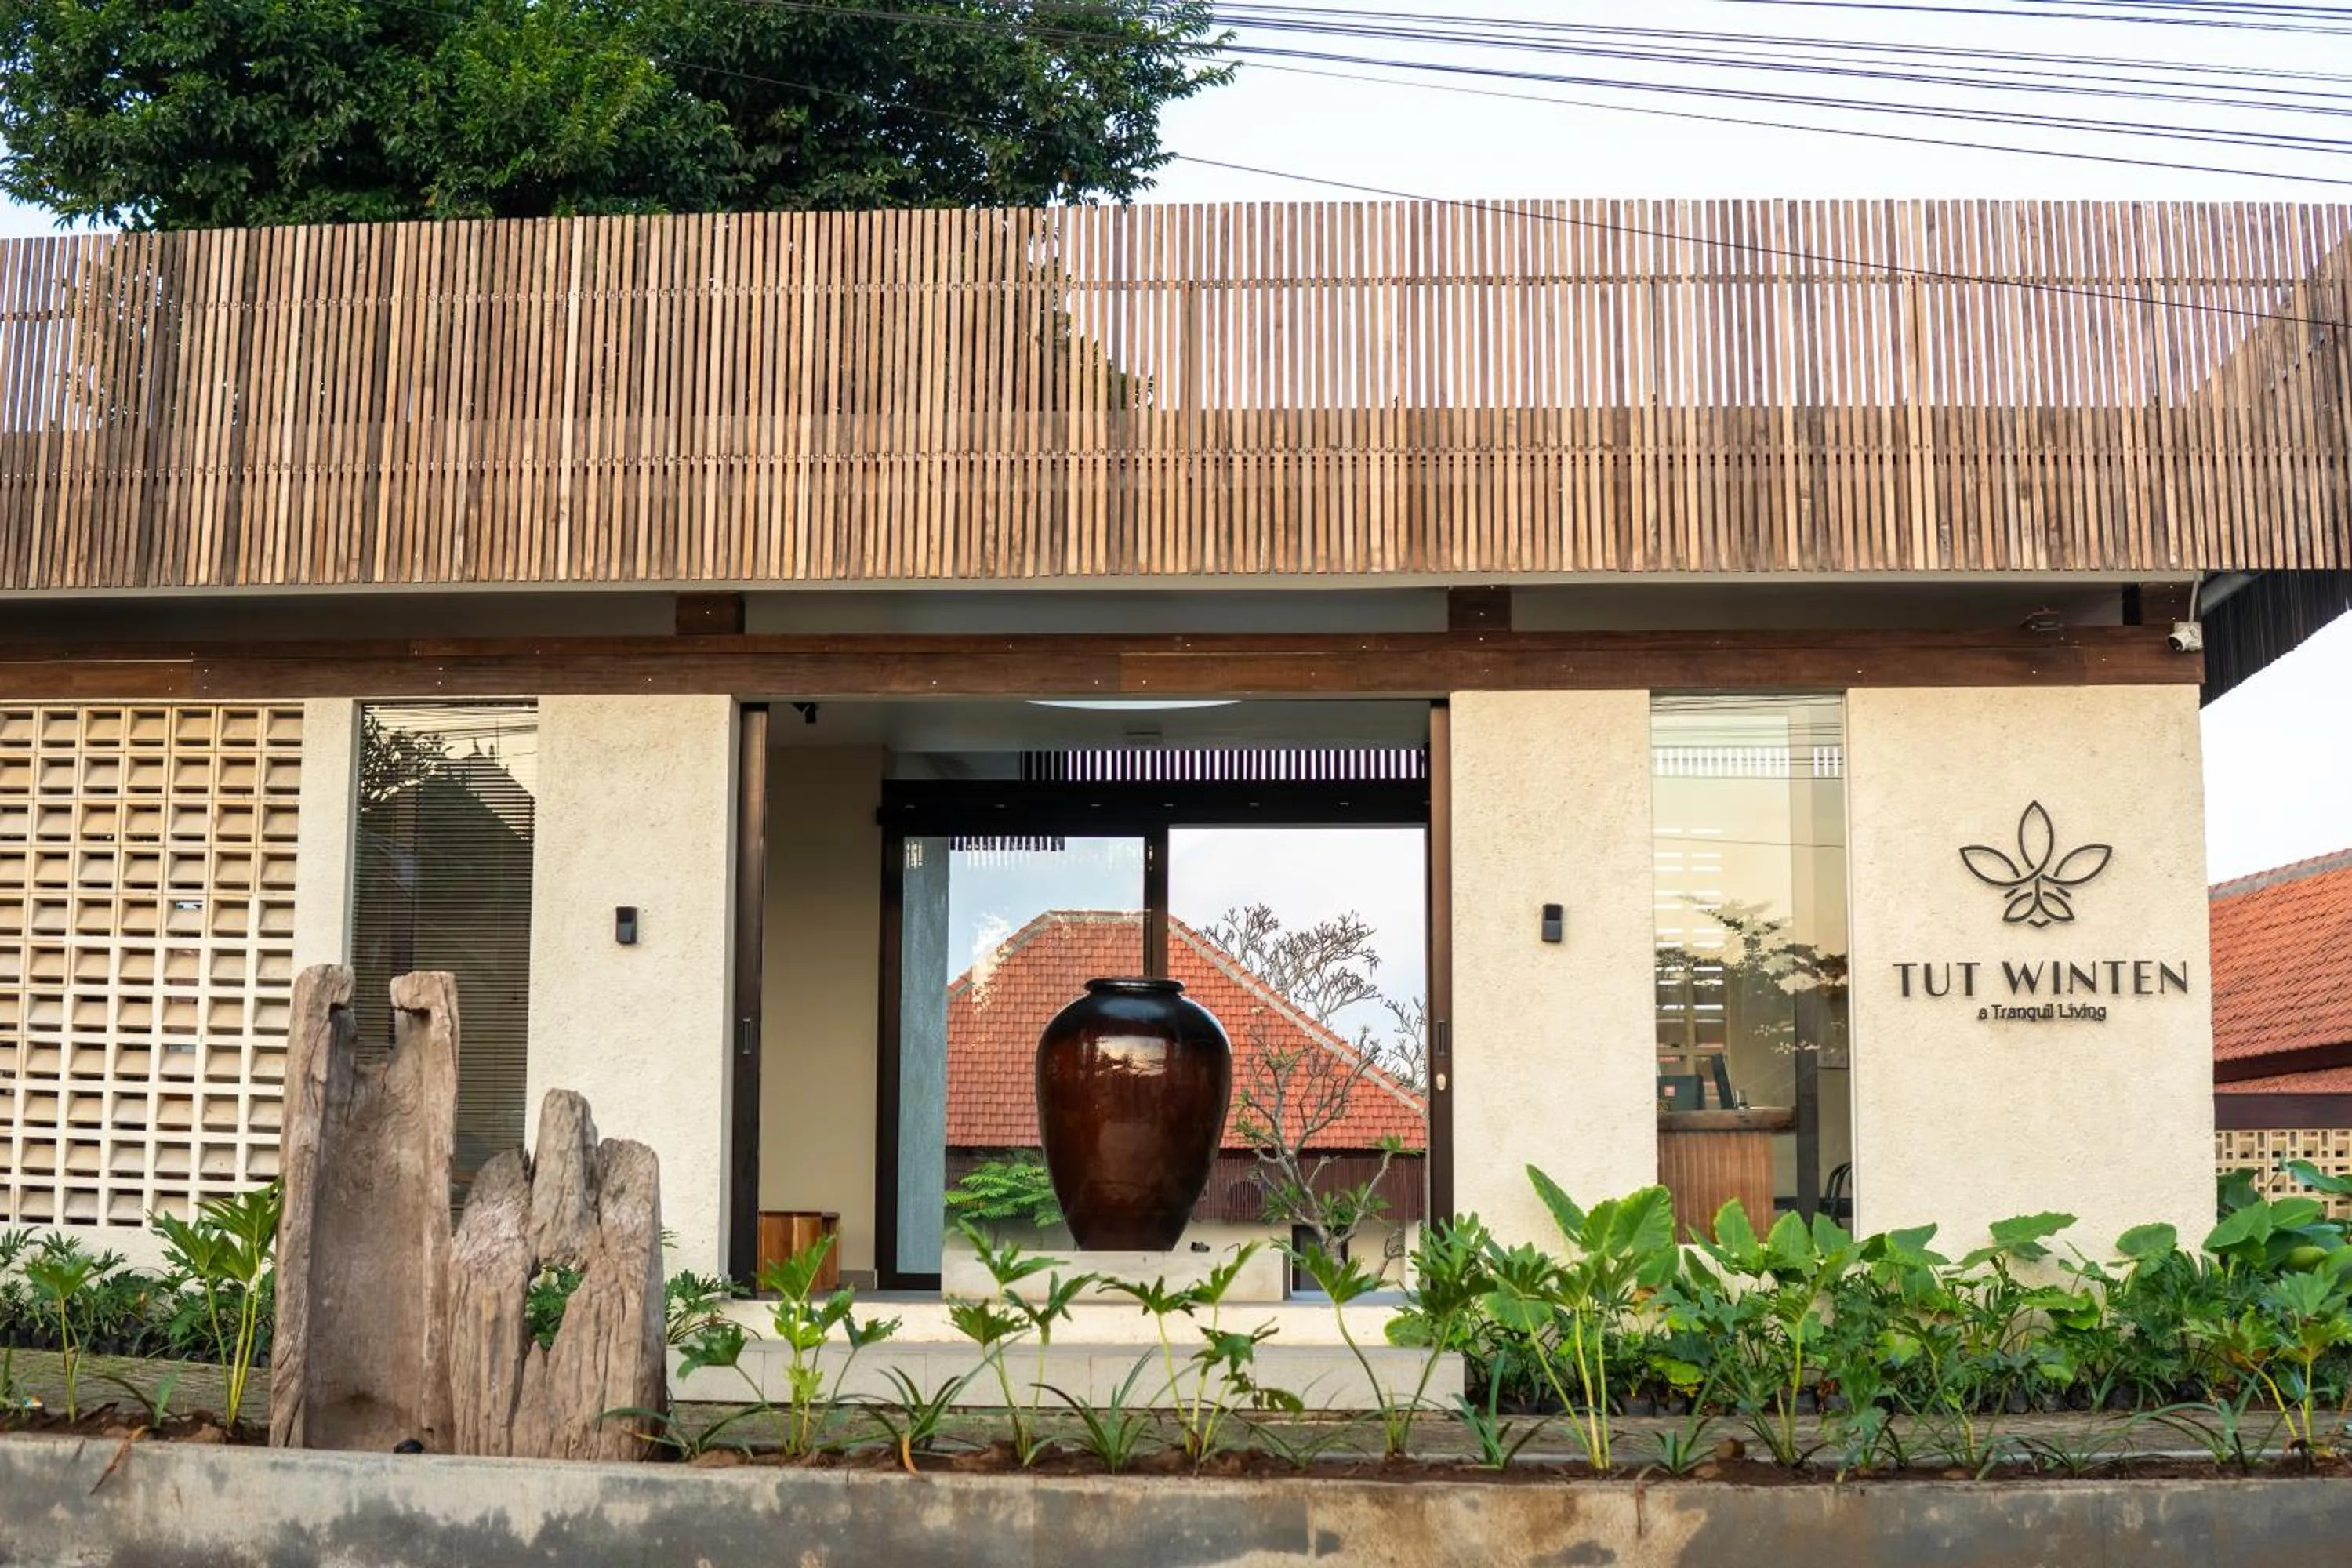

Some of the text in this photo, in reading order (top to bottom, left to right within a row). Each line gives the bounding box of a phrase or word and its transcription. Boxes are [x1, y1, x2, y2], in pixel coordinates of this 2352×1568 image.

[1893, 960, 2188, 997] TUT WINTEN
[1977, 1003, 2107, 1022] a Tranquil Living
